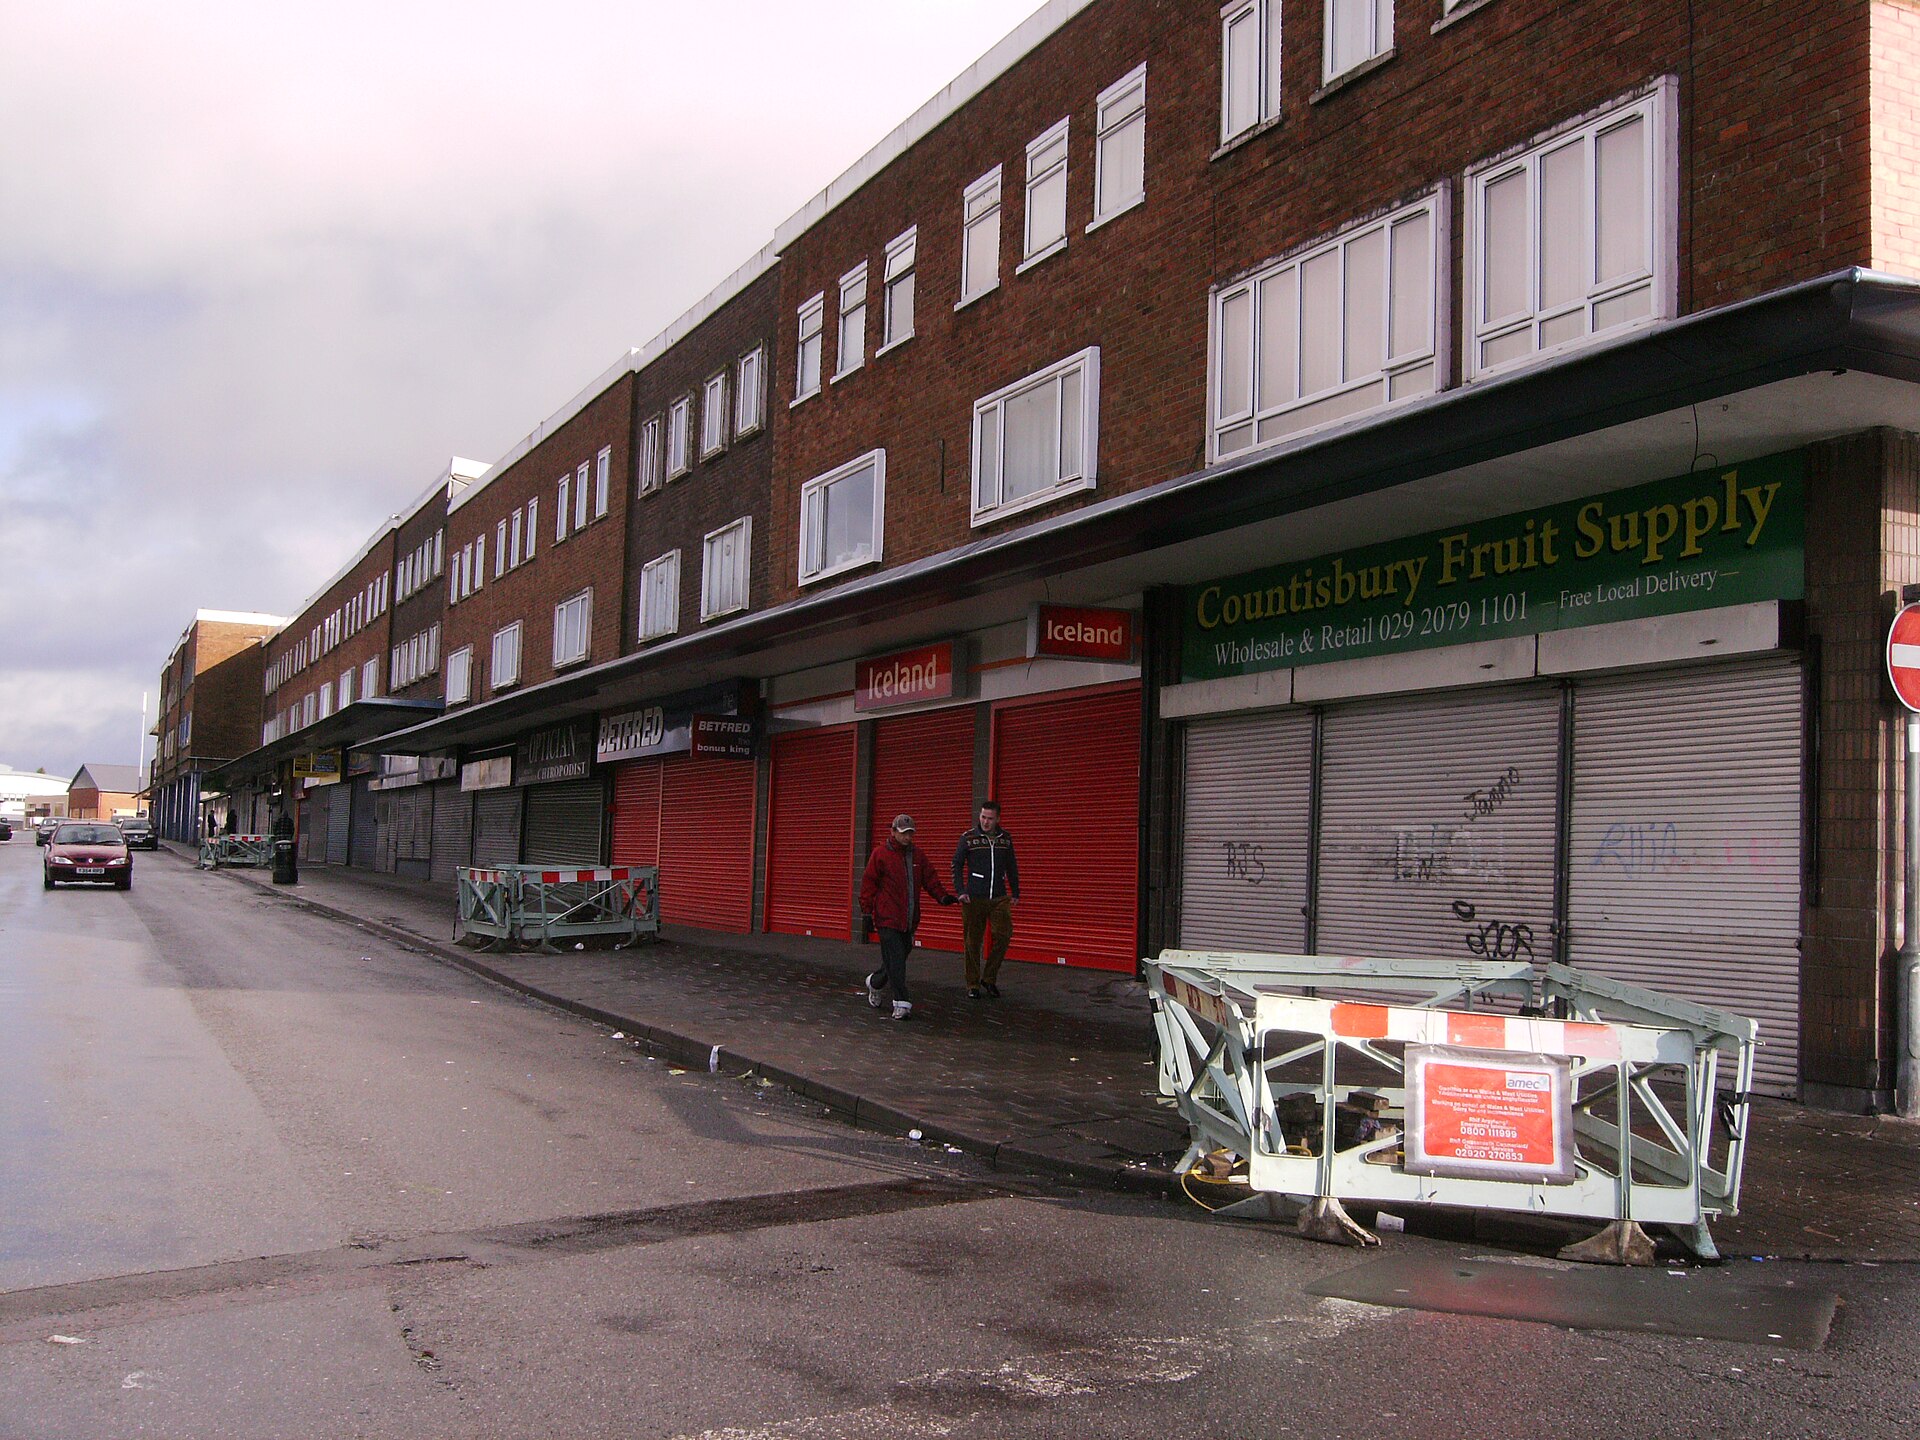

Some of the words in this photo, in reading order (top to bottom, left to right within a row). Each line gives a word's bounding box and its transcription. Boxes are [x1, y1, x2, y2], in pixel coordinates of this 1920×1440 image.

[1197, 556, 1428, 628] Countisbury
[1437, 519, 1559, 584] Fruit
[1575, 470, 1781, 564] Supply
[1560, 590, 1592, 608] Free
[1597, 578, 1640, 603] Local
[1645, 570, 1718, 595] Delivery
[1047, 620, 1123, 645] Iceland
[1215, 632, 1294, 666] Wholesale
[1299, 628, 1314, 653] &
[1320, 617, 1373, 650] Retail
[1380, 610, 1414, 640] 029
[1420, 601, 1470, 635] 2079
[1480, 591, 1527, 626] 1101
[868, 653, 937, 700] Iceland
[598, 706, 664, 754] BETFRED
[698, 720, 750, 733] BETFRED
[529, 725, 577, 764] OPTICIAN
[697, 743, 726, 752] bonus
[729, 745, 750, 755] king
[537, 761, 585, 780] CHIROPODIST
[1507, 1079, 1540, 1089] amec
[1460, 1126, 1485, 1136] 0800
[1488, 1129, 1517, 1138] 111999
[1455, 1148, 1486, 1158] 02920
[1488, 1150, 1523, 1161] 270653
